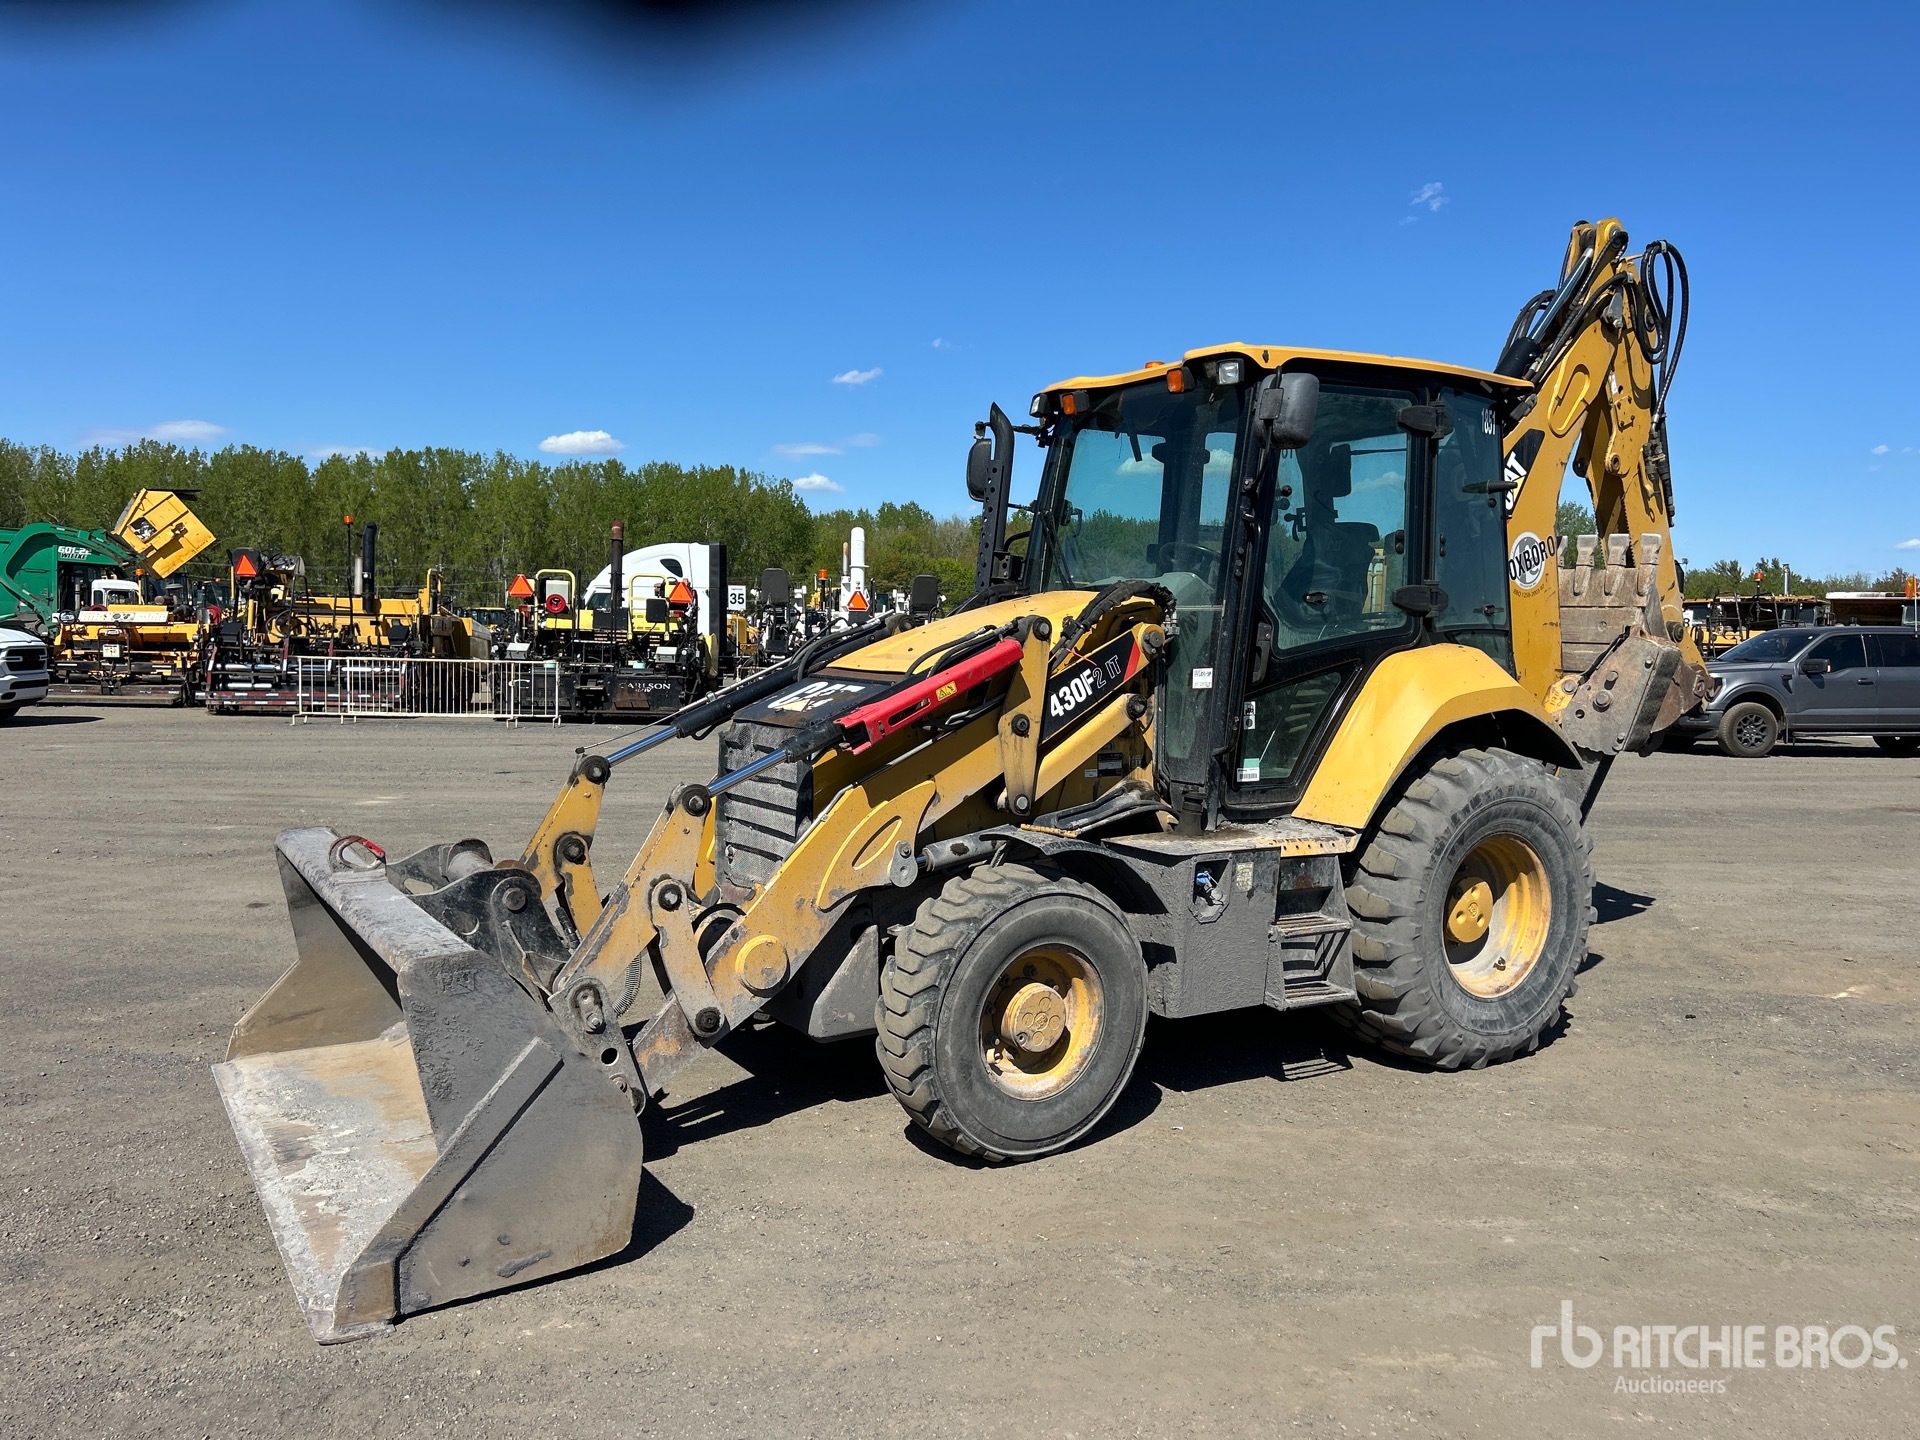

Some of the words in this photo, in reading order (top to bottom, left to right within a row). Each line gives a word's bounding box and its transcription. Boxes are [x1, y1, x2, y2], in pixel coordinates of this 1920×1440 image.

[1481, 408, 1496, 435] 1851
[1508, 535, 1556, 581] OXBORO
[730, 593, 745, 605] 35
[1104, 654, 1122, 679] IT
